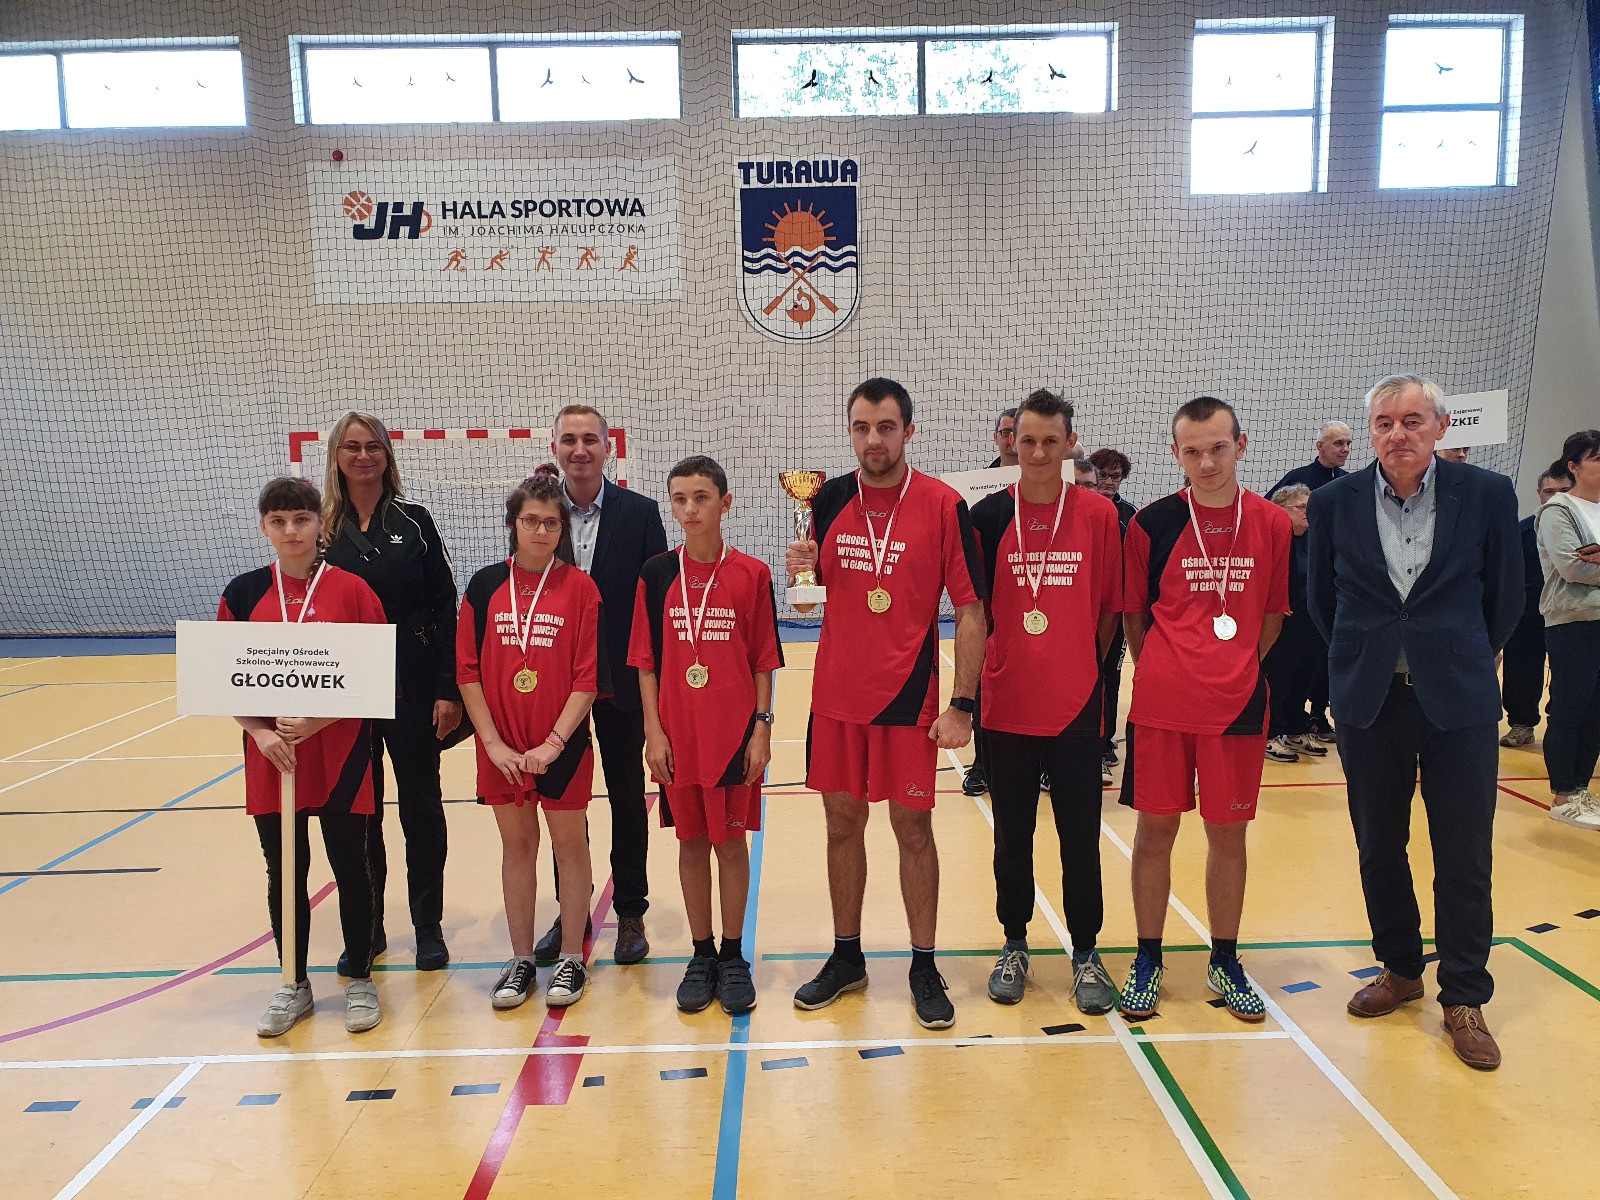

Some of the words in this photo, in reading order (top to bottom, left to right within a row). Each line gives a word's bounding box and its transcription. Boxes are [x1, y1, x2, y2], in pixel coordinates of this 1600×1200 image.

[738, 159, 858, 184] TURAWA
[441, 201, 506, 219] HALA
[511, 198, 646, 218] SPORTOWA
[443, 226, 463, 235] IM.
[470, 225, 544, 235] JOACHIMA
[550, 223, 646, 234] HALUPCZOKA
[246, 648, 290, 656] Specjalny
[292, 648, 330, 656] Ośrodek
[236, 658, 340, 668] Szkolno-Wychowawczy
[231, 669, 346, 689] GŁOGÓWEK
